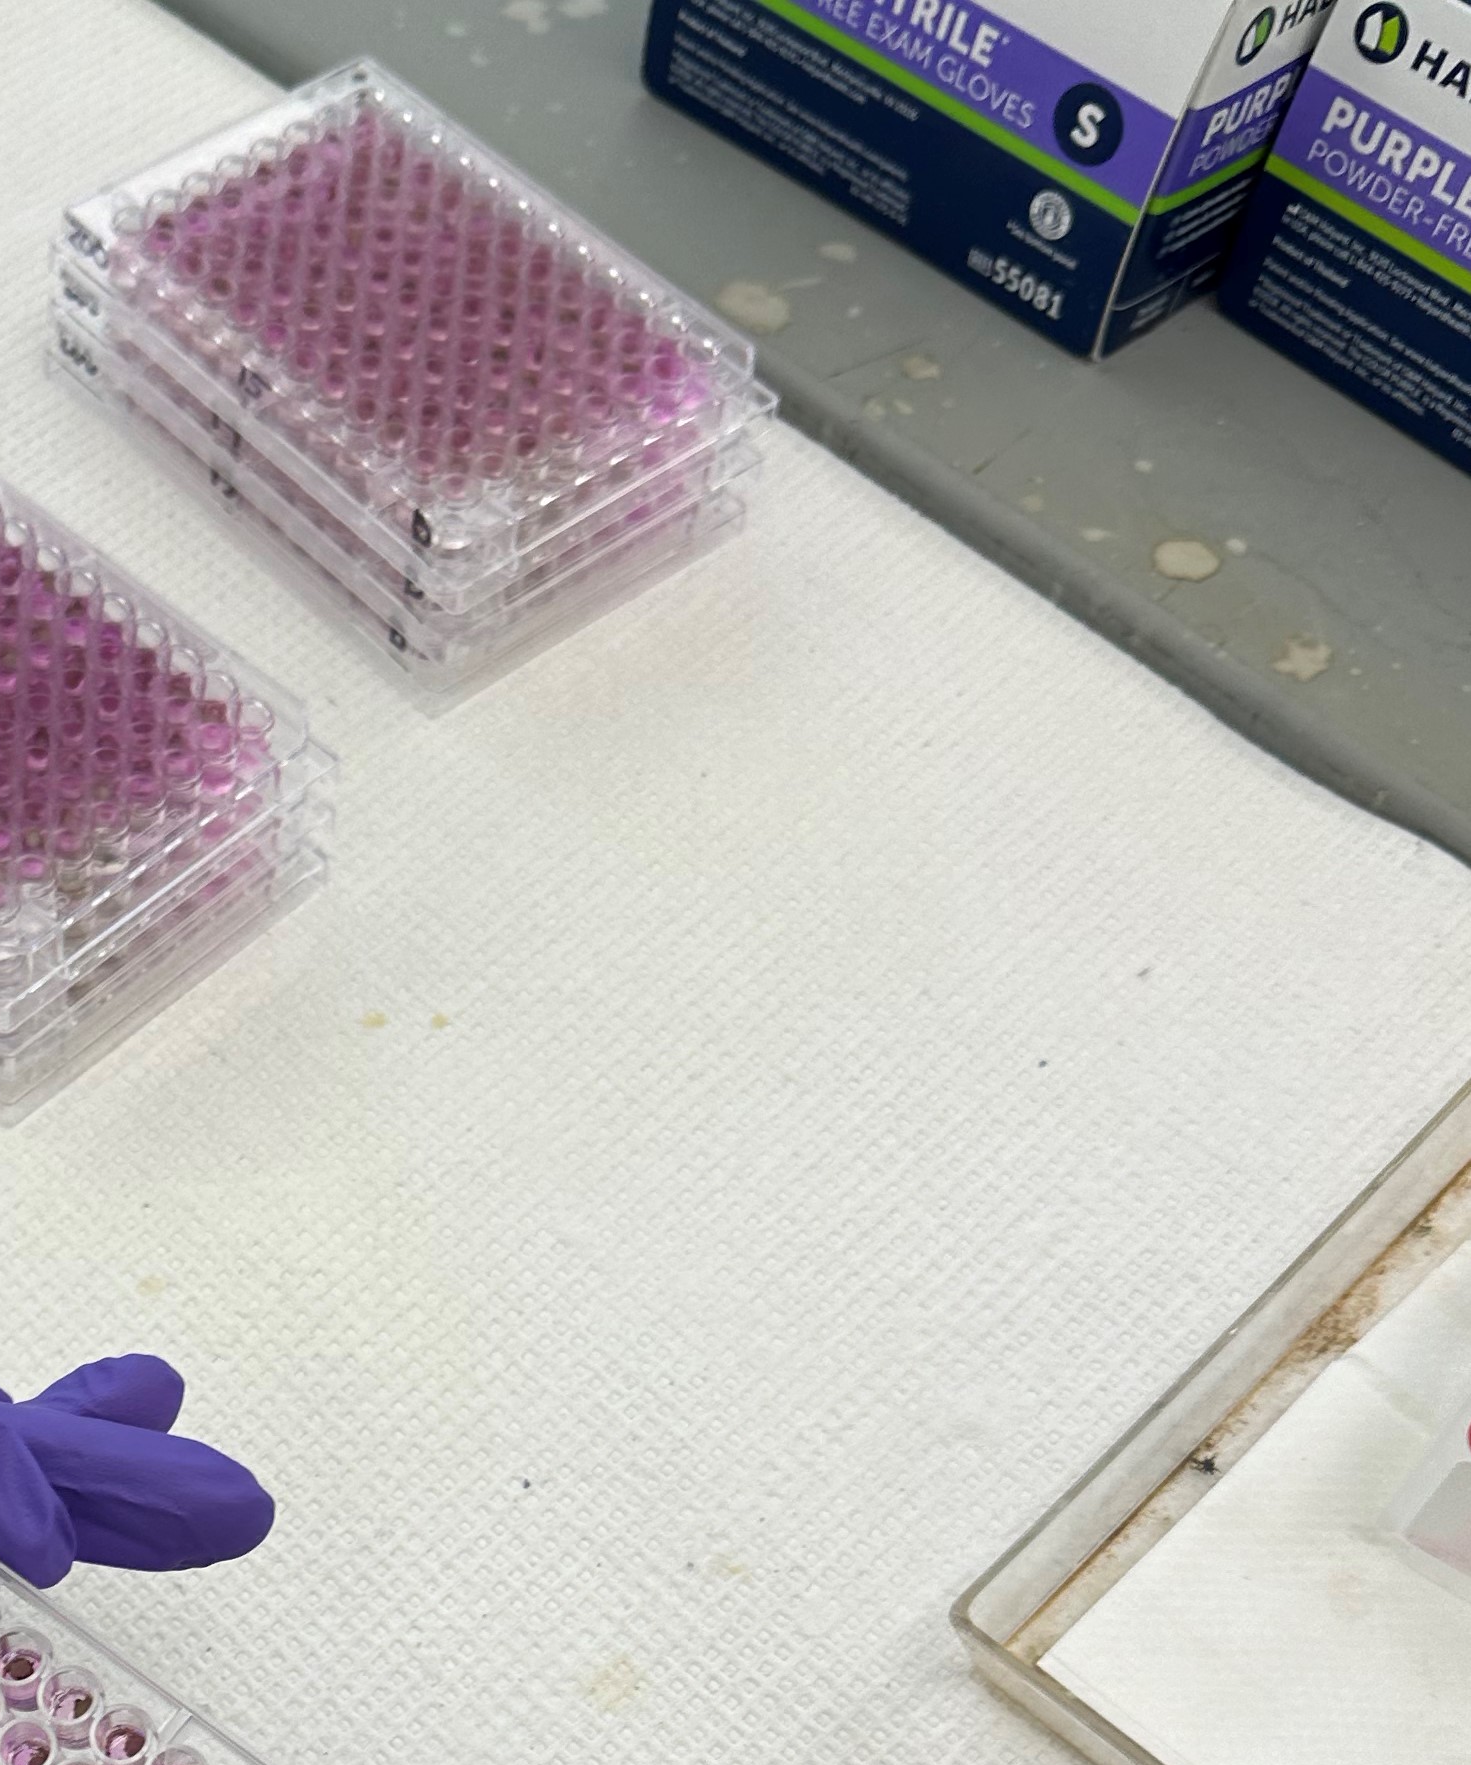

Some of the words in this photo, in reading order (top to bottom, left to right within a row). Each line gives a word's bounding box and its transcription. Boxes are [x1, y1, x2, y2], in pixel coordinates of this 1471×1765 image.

[874, 0, 1000, 68] RILE
[865, 11, 934, 69] EXAM
[936, 55, 1035, 129] GLOVES
[1410, 39, 1471, 100] HA
[1069, 102, 1107, 150] S
[990, 257, 1065, 321] 55081
